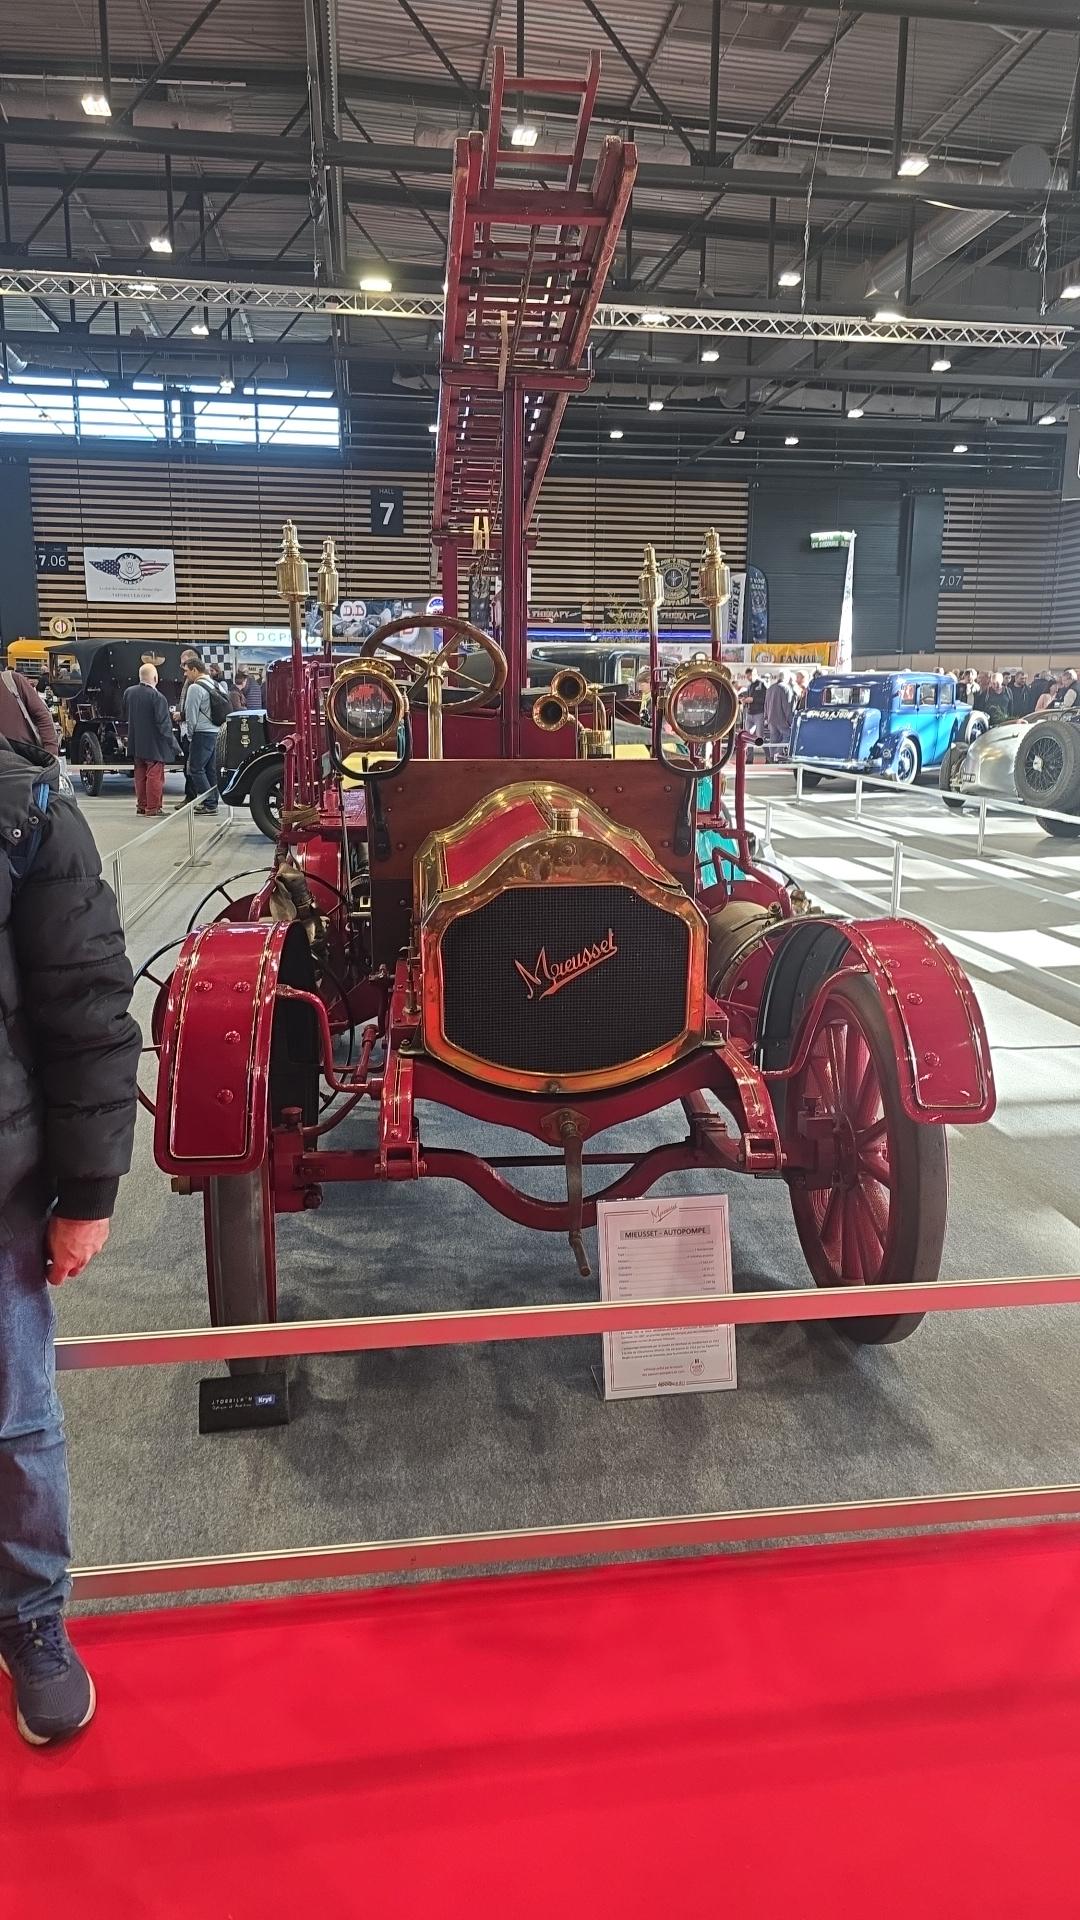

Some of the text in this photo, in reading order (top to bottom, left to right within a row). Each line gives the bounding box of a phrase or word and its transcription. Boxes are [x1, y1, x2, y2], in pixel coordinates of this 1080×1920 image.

[380, 502, 395, 525] 7
[38, 555, 66, 567] 7.06
[940, 575, 962, 586] 7.07
[531, 610, 570, 619] THERAPY
[660, 612, 698, 620] THERAPY
[515, 928, 618, 1000] Mieusset
[624, 1230, 657, 1238] MIEUSSET
[664, 1227, 706, 1236] AUTOPOMPE
